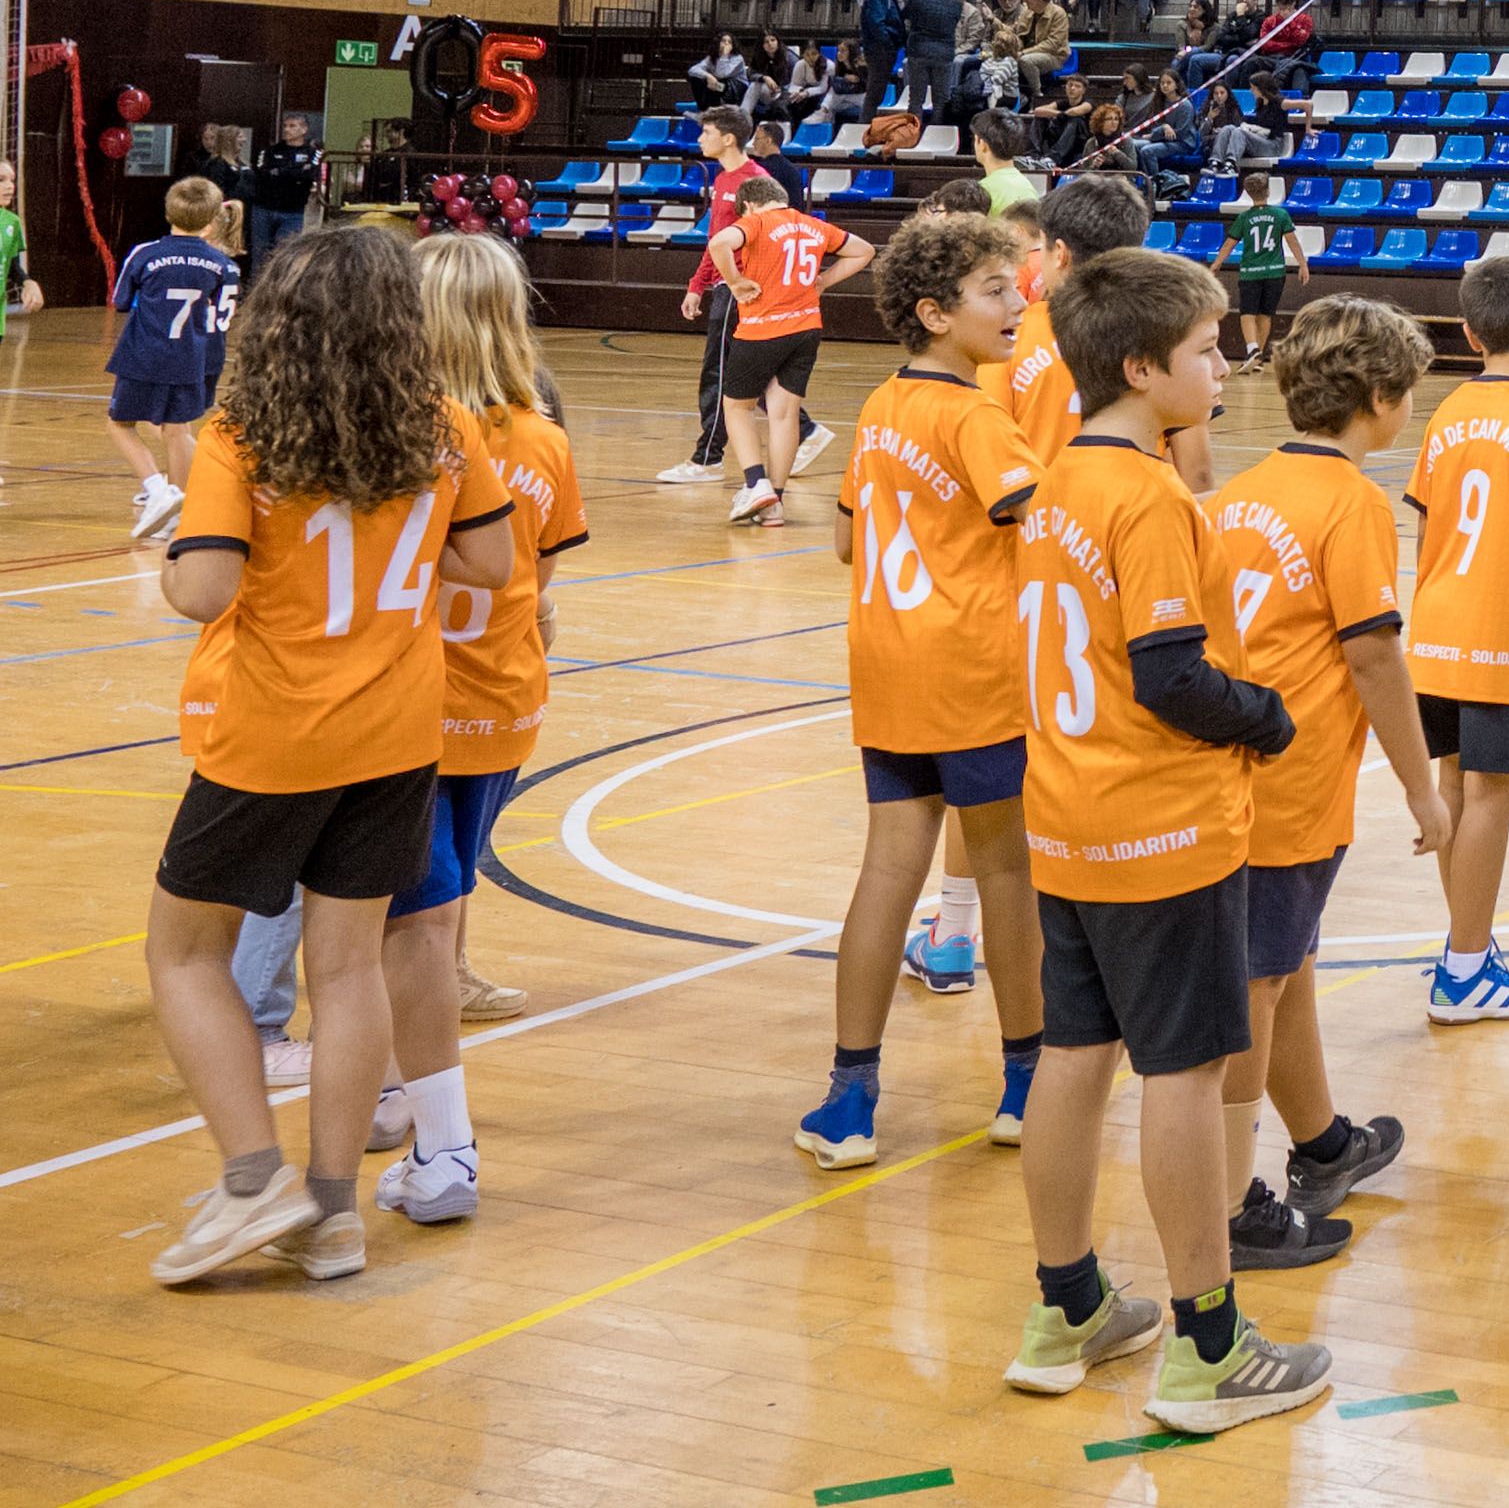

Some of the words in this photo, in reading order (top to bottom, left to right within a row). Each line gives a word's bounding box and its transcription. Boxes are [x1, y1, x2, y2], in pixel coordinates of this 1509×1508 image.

[390, 14, 422, 61] A
[782, 238, 818, 287] 15
[1250, 224, 1275, 253] 14
[147, 255, 186, 272] SANTA
[187, 256, 223, 275] ISABEL
[166, 288, 202, 339] 7
[1012, 344, 1053, 394] TURÓ
[1443, 420, 1466, 448] DE
[1468, 417, 1502, 441] CAN
[508, 464, 554, 525] MATE
[899, 439, 961, 502] MATES
[859, 482, 934, 611] 16
[1225, 501, 1247, 532] DE
[1264, 516, 1314, 593] MATES
[1456, 468, 1491, 576] 9
[305, 493, 435, 638] 14
[1023, 508, 1048, 546] DE
[1060, 519, 1118, 601] MATES
[1018, 581, 1097, 737] 13
[1413, 642, 1460, 661] RESPECTE
[1081, 826, 1199, 862] SOLIDARITAT
